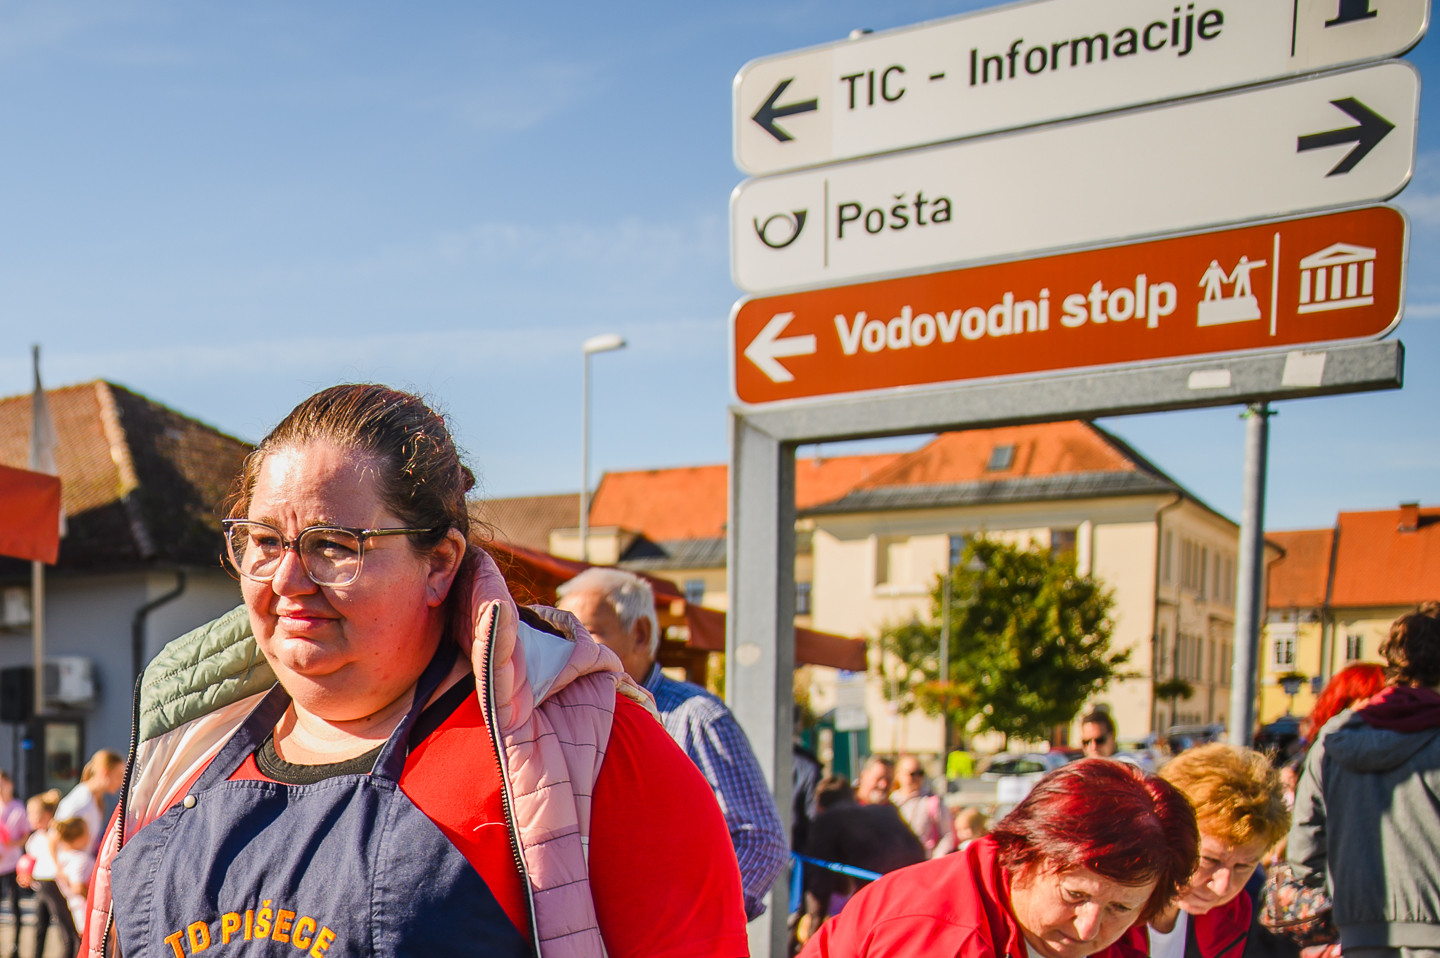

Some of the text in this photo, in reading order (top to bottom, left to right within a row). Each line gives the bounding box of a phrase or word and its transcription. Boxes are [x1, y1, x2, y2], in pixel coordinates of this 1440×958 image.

[841, 64, 906, 110] TIC
[969, 3, 1225, 87] Informacije
[836, 192, 953, 239] Pošta
[834, 273, 1177, 356] Vodovodni stolp
